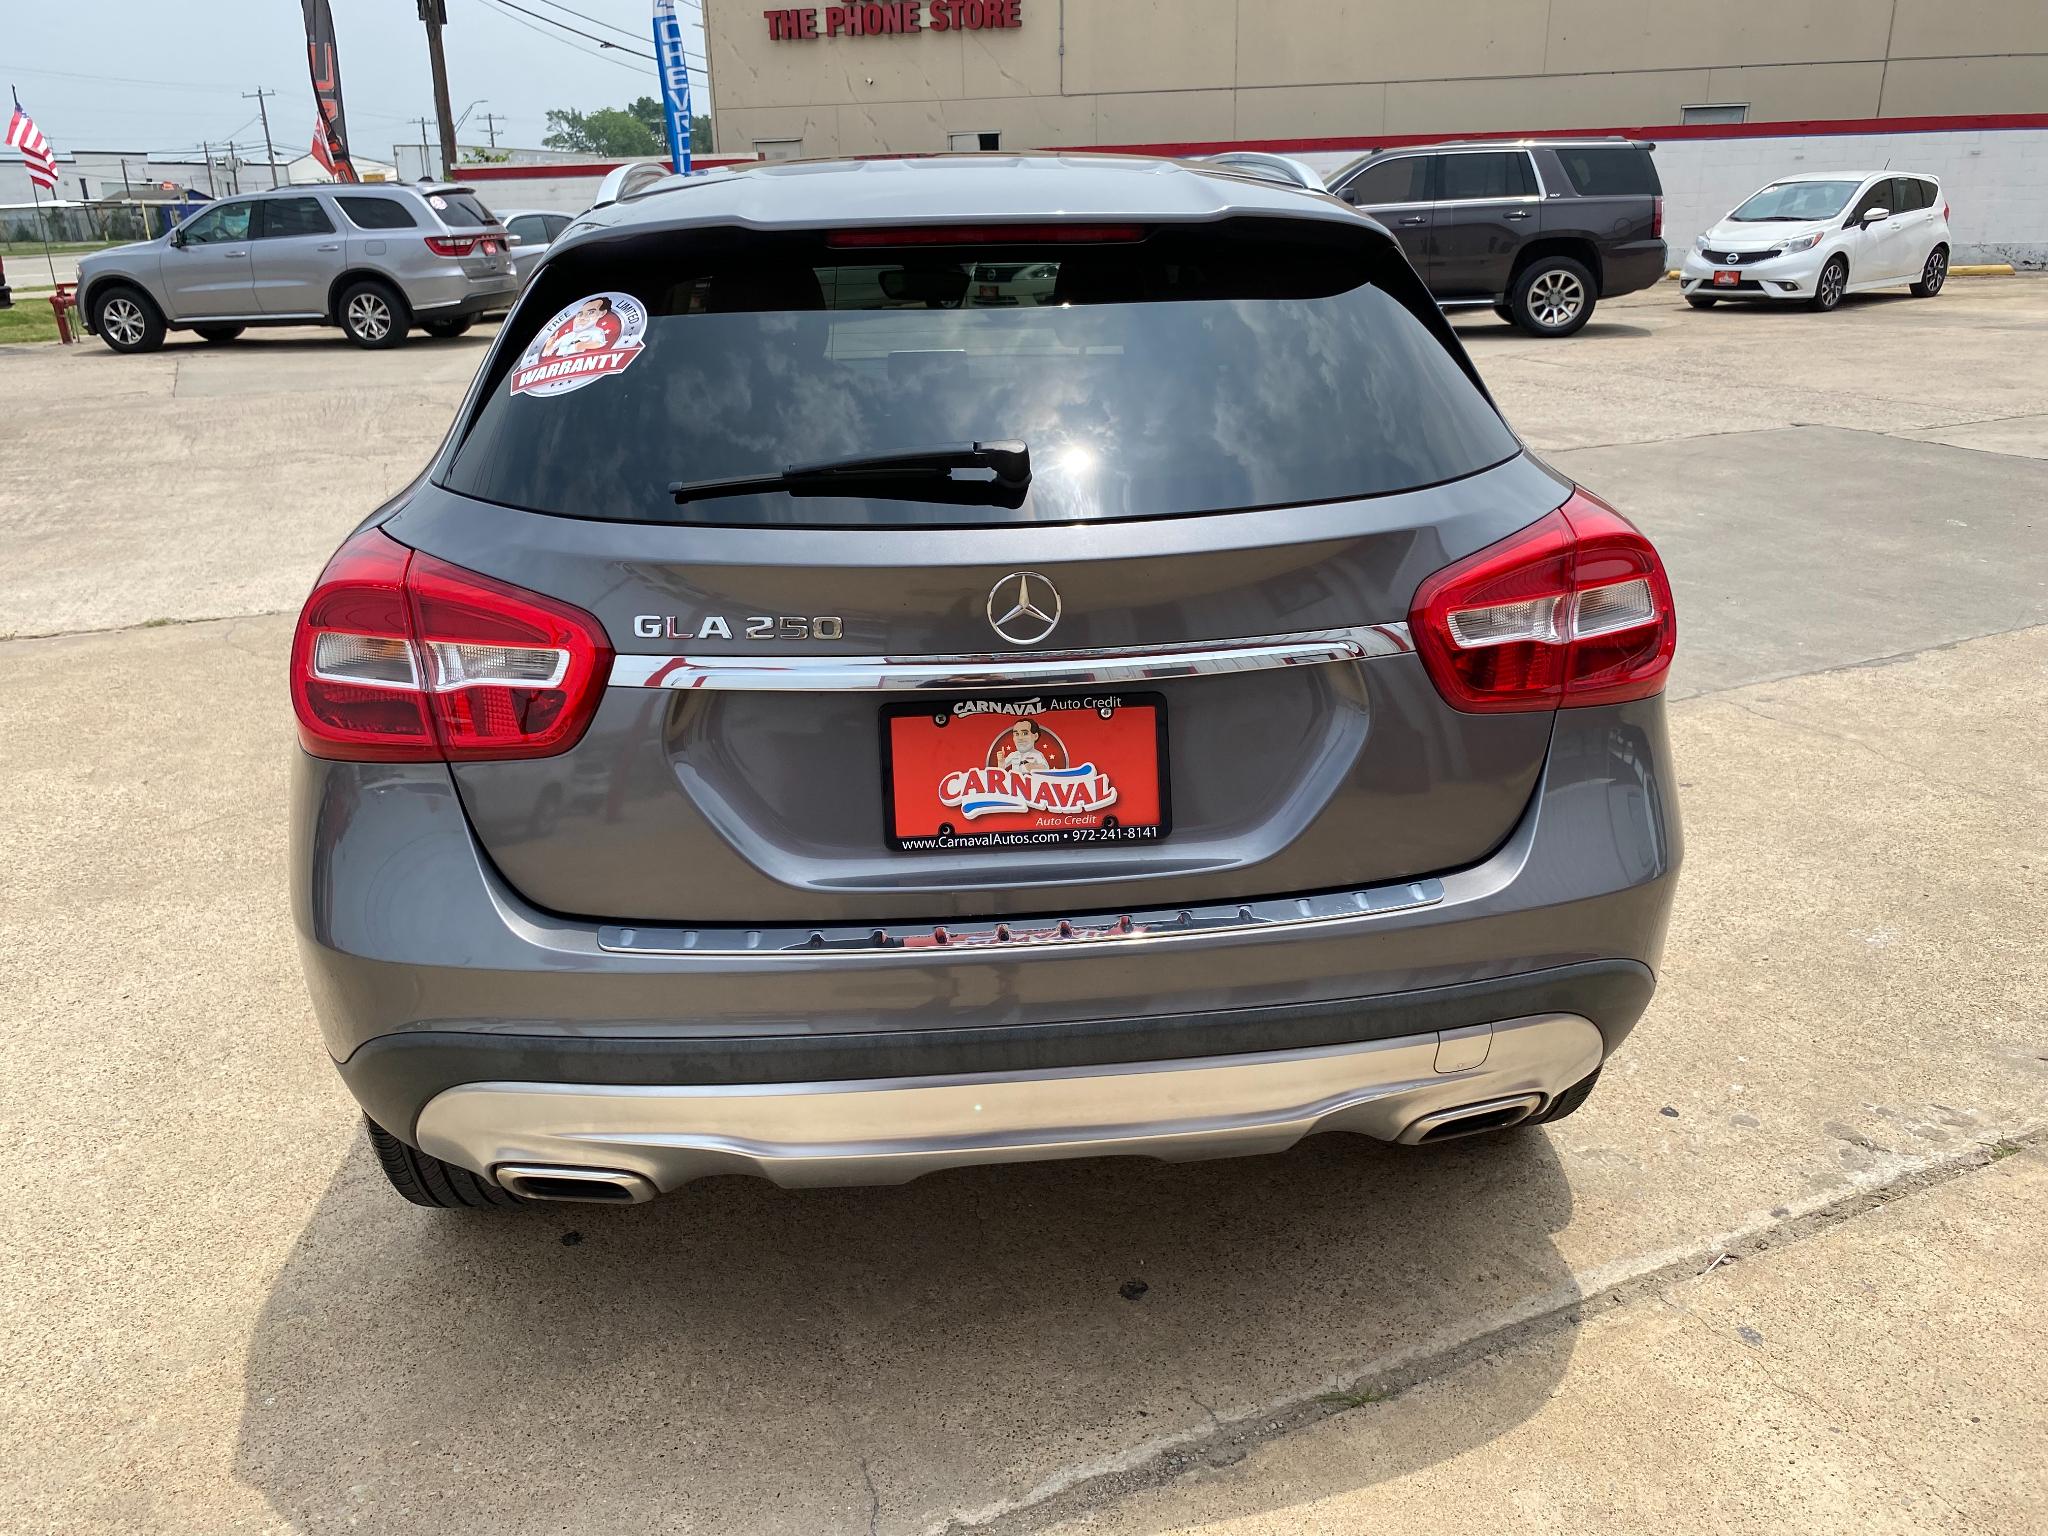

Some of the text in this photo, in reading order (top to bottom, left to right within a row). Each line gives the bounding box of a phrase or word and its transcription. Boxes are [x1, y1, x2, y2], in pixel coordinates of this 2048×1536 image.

[764, 0, 1022, 40] THE PHONE STORE
[547, 299, 640, 332] FREE LIMITED
[518, 352, 625, 387] WARRANTY
[633, 615, 844, 640] GLA 250
[953, 695, 1123, 717] CARNAVAL Auto Credit
[939, 768, 1114, 810] CARNAVAL
[1035, 814, 1097, 827] Auto Credit
[902, 826, 1158, 850] www.CarnavalAutos.com 972-241-8141
